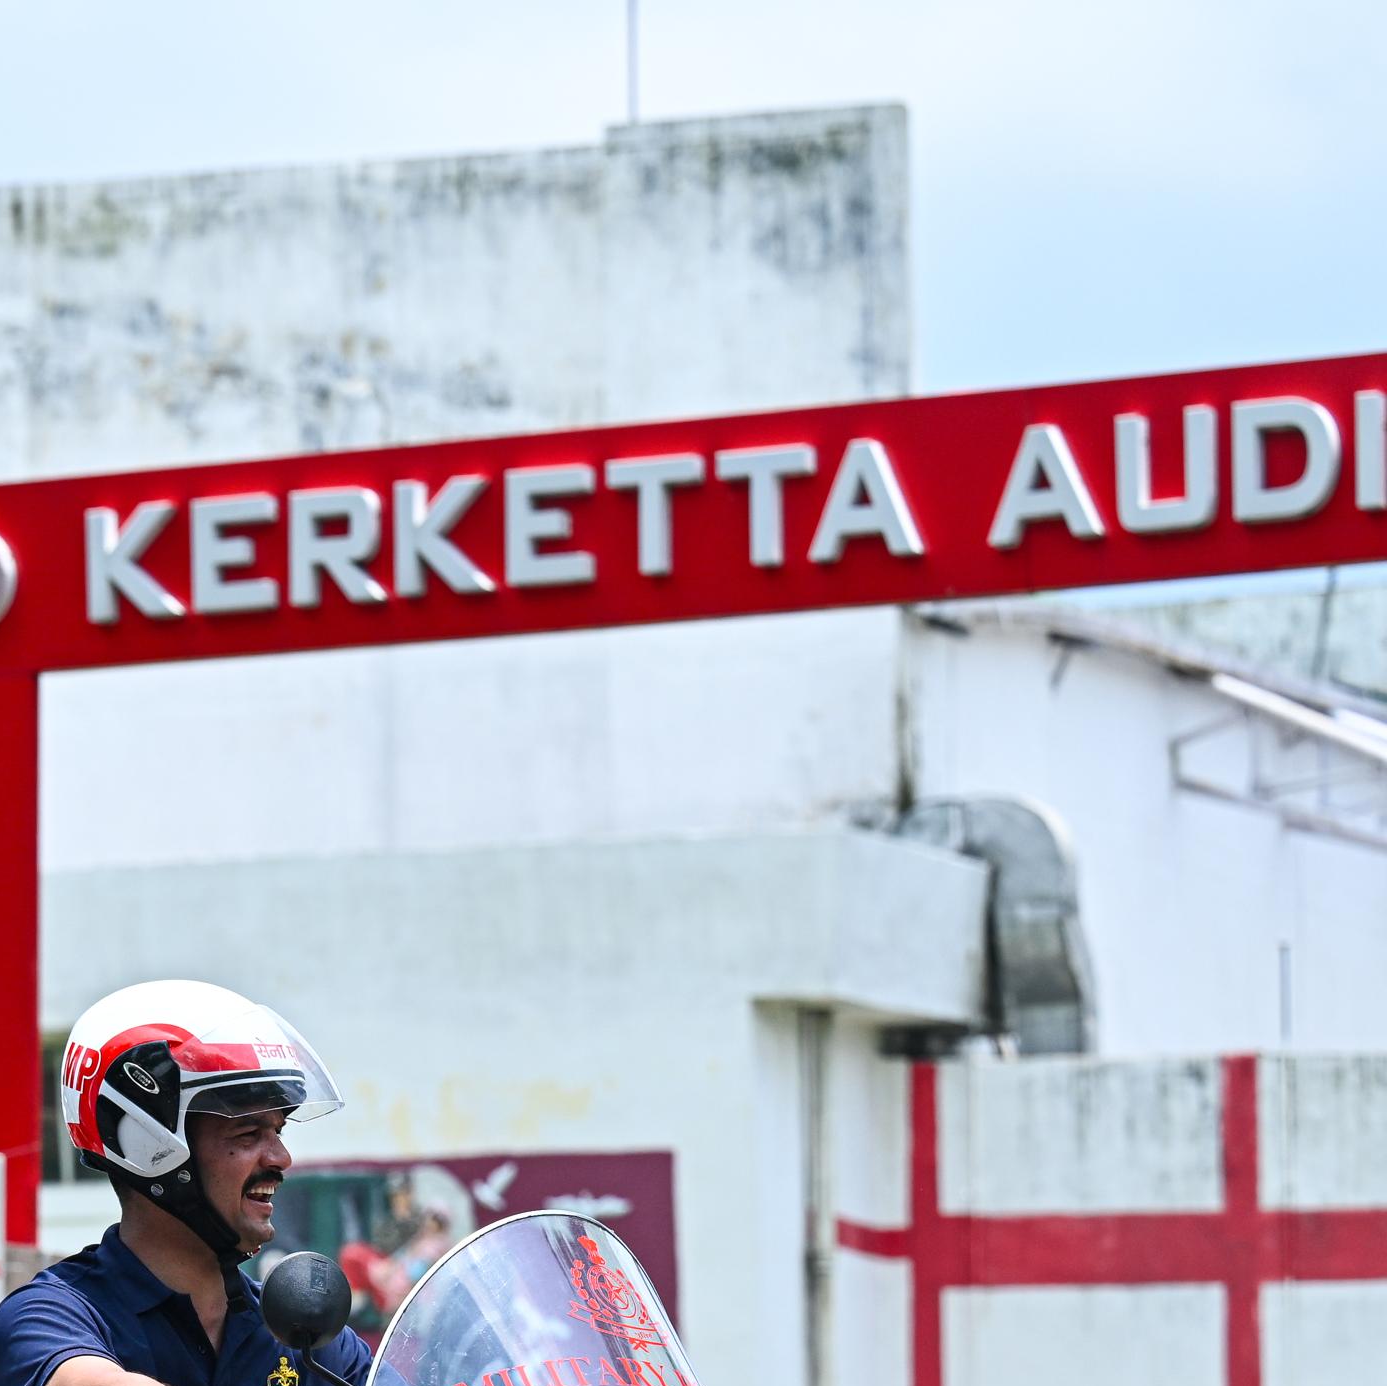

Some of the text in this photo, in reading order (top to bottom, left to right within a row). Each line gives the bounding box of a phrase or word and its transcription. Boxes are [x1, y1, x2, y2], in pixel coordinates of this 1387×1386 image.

[84, 389, 1387, 625] KERKETTA AUDI
[63, 1042, 102, 1093] MP
